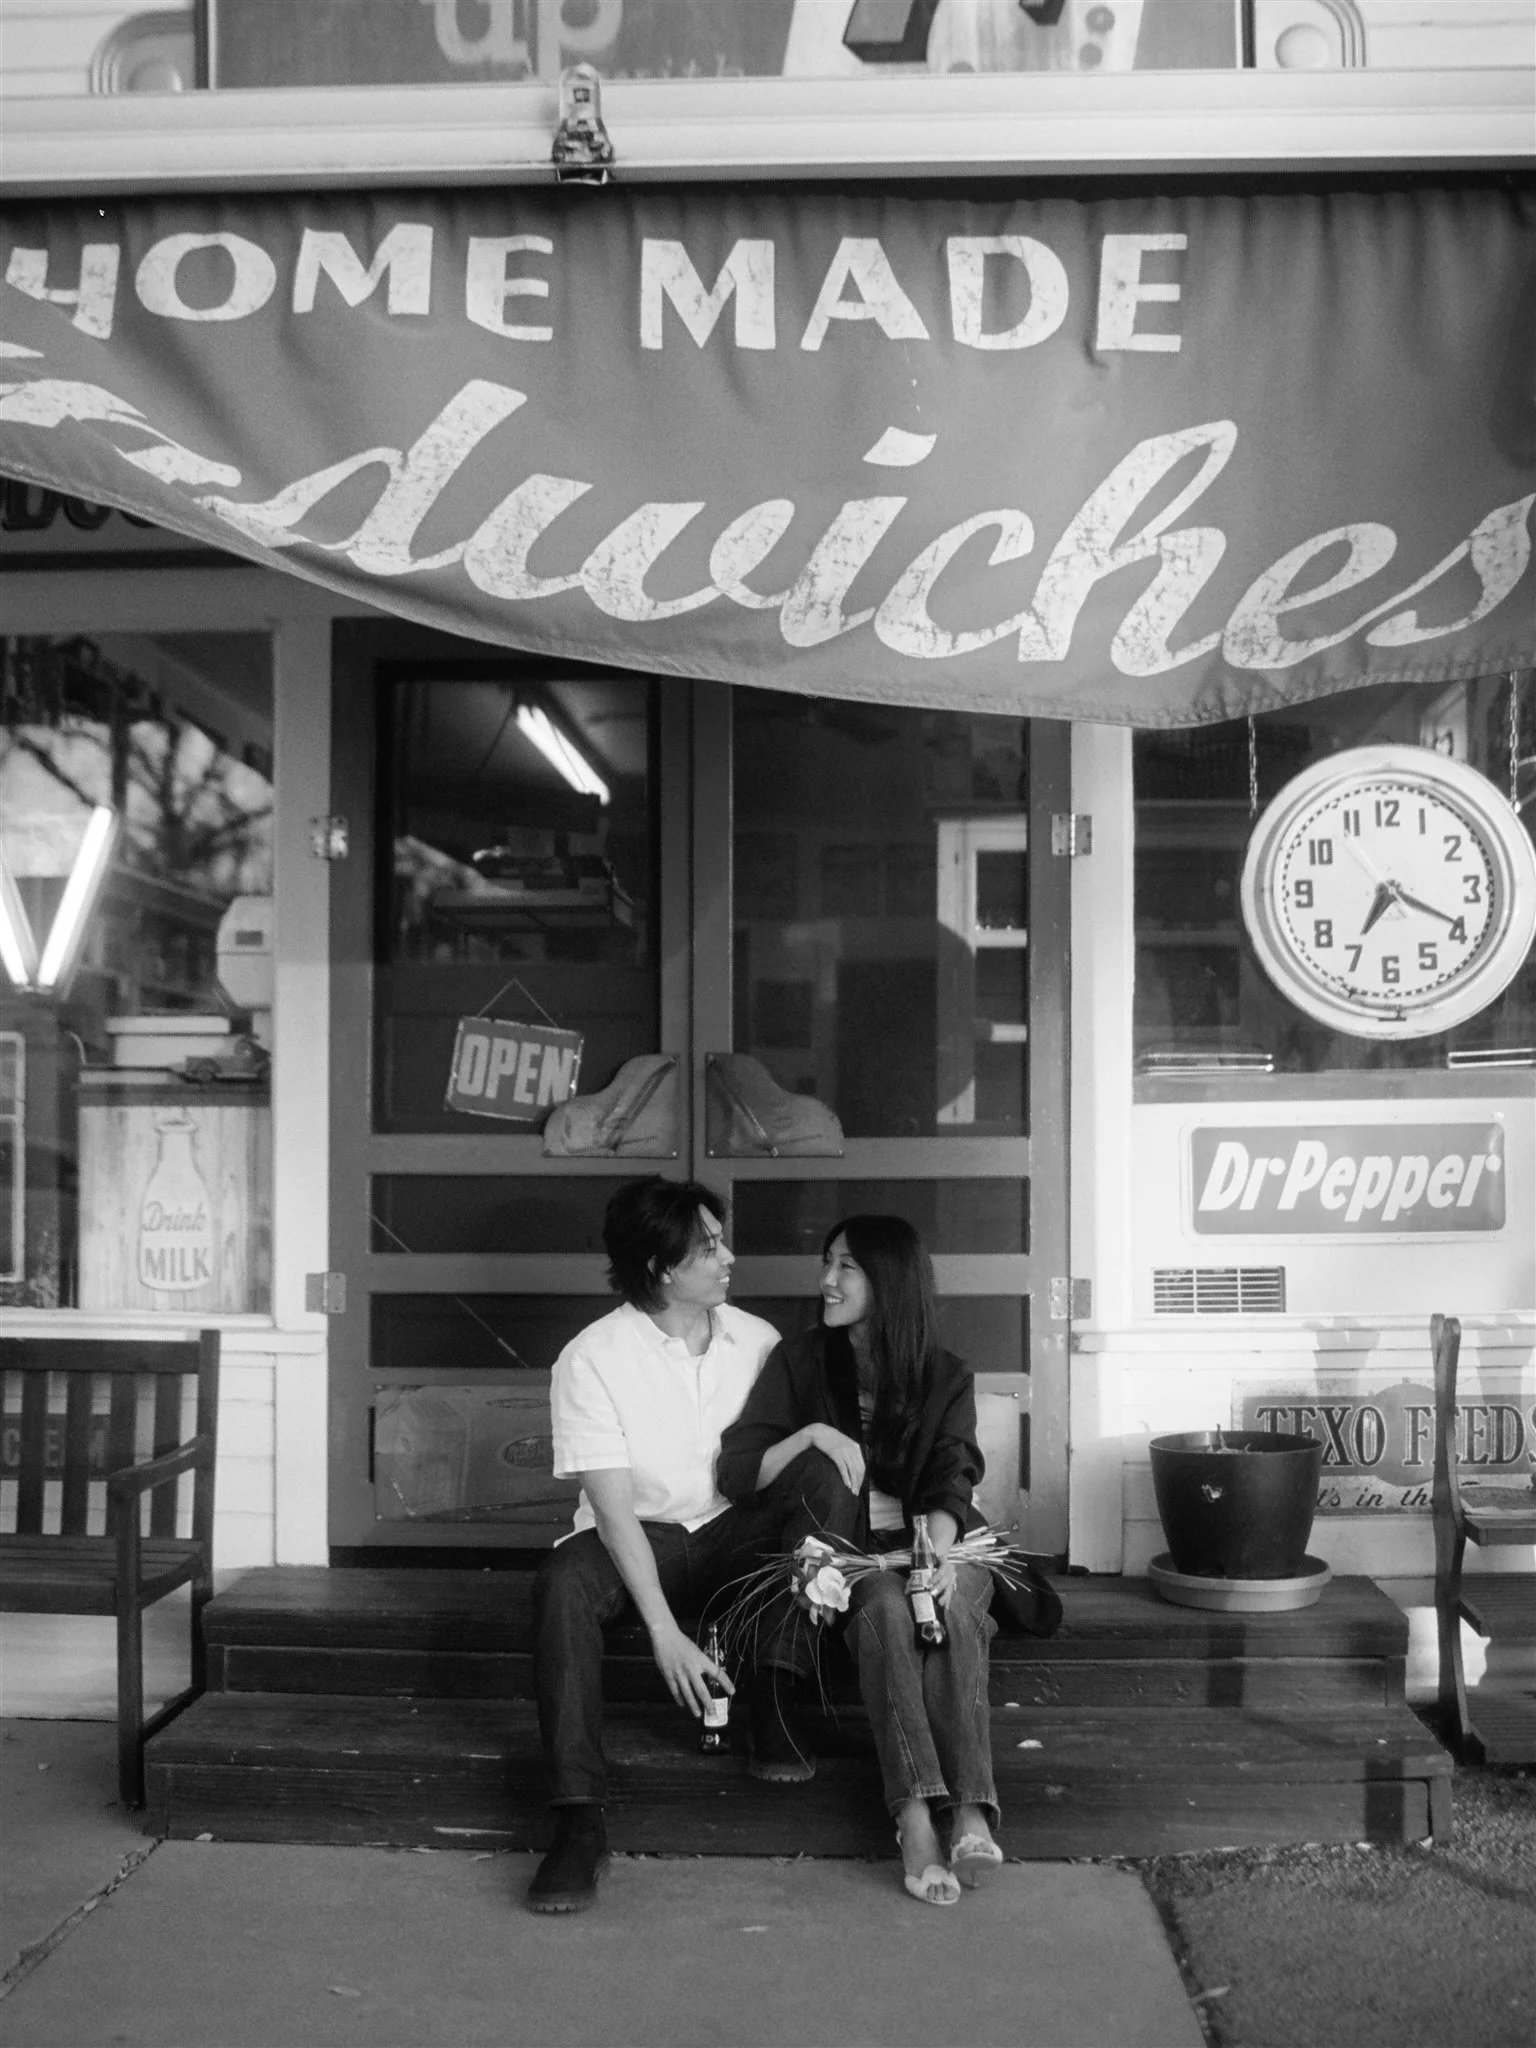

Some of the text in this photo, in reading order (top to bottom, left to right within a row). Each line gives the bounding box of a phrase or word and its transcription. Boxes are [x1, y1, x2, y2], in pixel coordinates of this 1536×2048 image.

[5, 223, 1188, 352] HOME MADE
[1343, 809, 1361, 837] 11
[1375, 800, 1400, 827] 12
[1418, 808, 1426, 835] 1
[1309, 839, 1333, 866] 10
[1443, 835, 1462, 862] 2
[1294, 879, 1314, 909] 9
[1462, 875, 1481, 904] 3
[1314, 919, 1333, 949] 8
[1448, 915, 1468, 945] 4
[1344, 944, 1363, 973] 7
[1381, 956, 1400, 984] 6
[1418, 942, 1438, 970] 5
[456, 1033, 575, 1107] OPEN
[141, 1200, 206, 1232] Drink
[144, 1247, 210, 1282] MILK
[1401, 1404, 1536, 1467] FED
[1355, 1486, 1383, 1508] in
[1400, 1487, 1434, 1508] th
